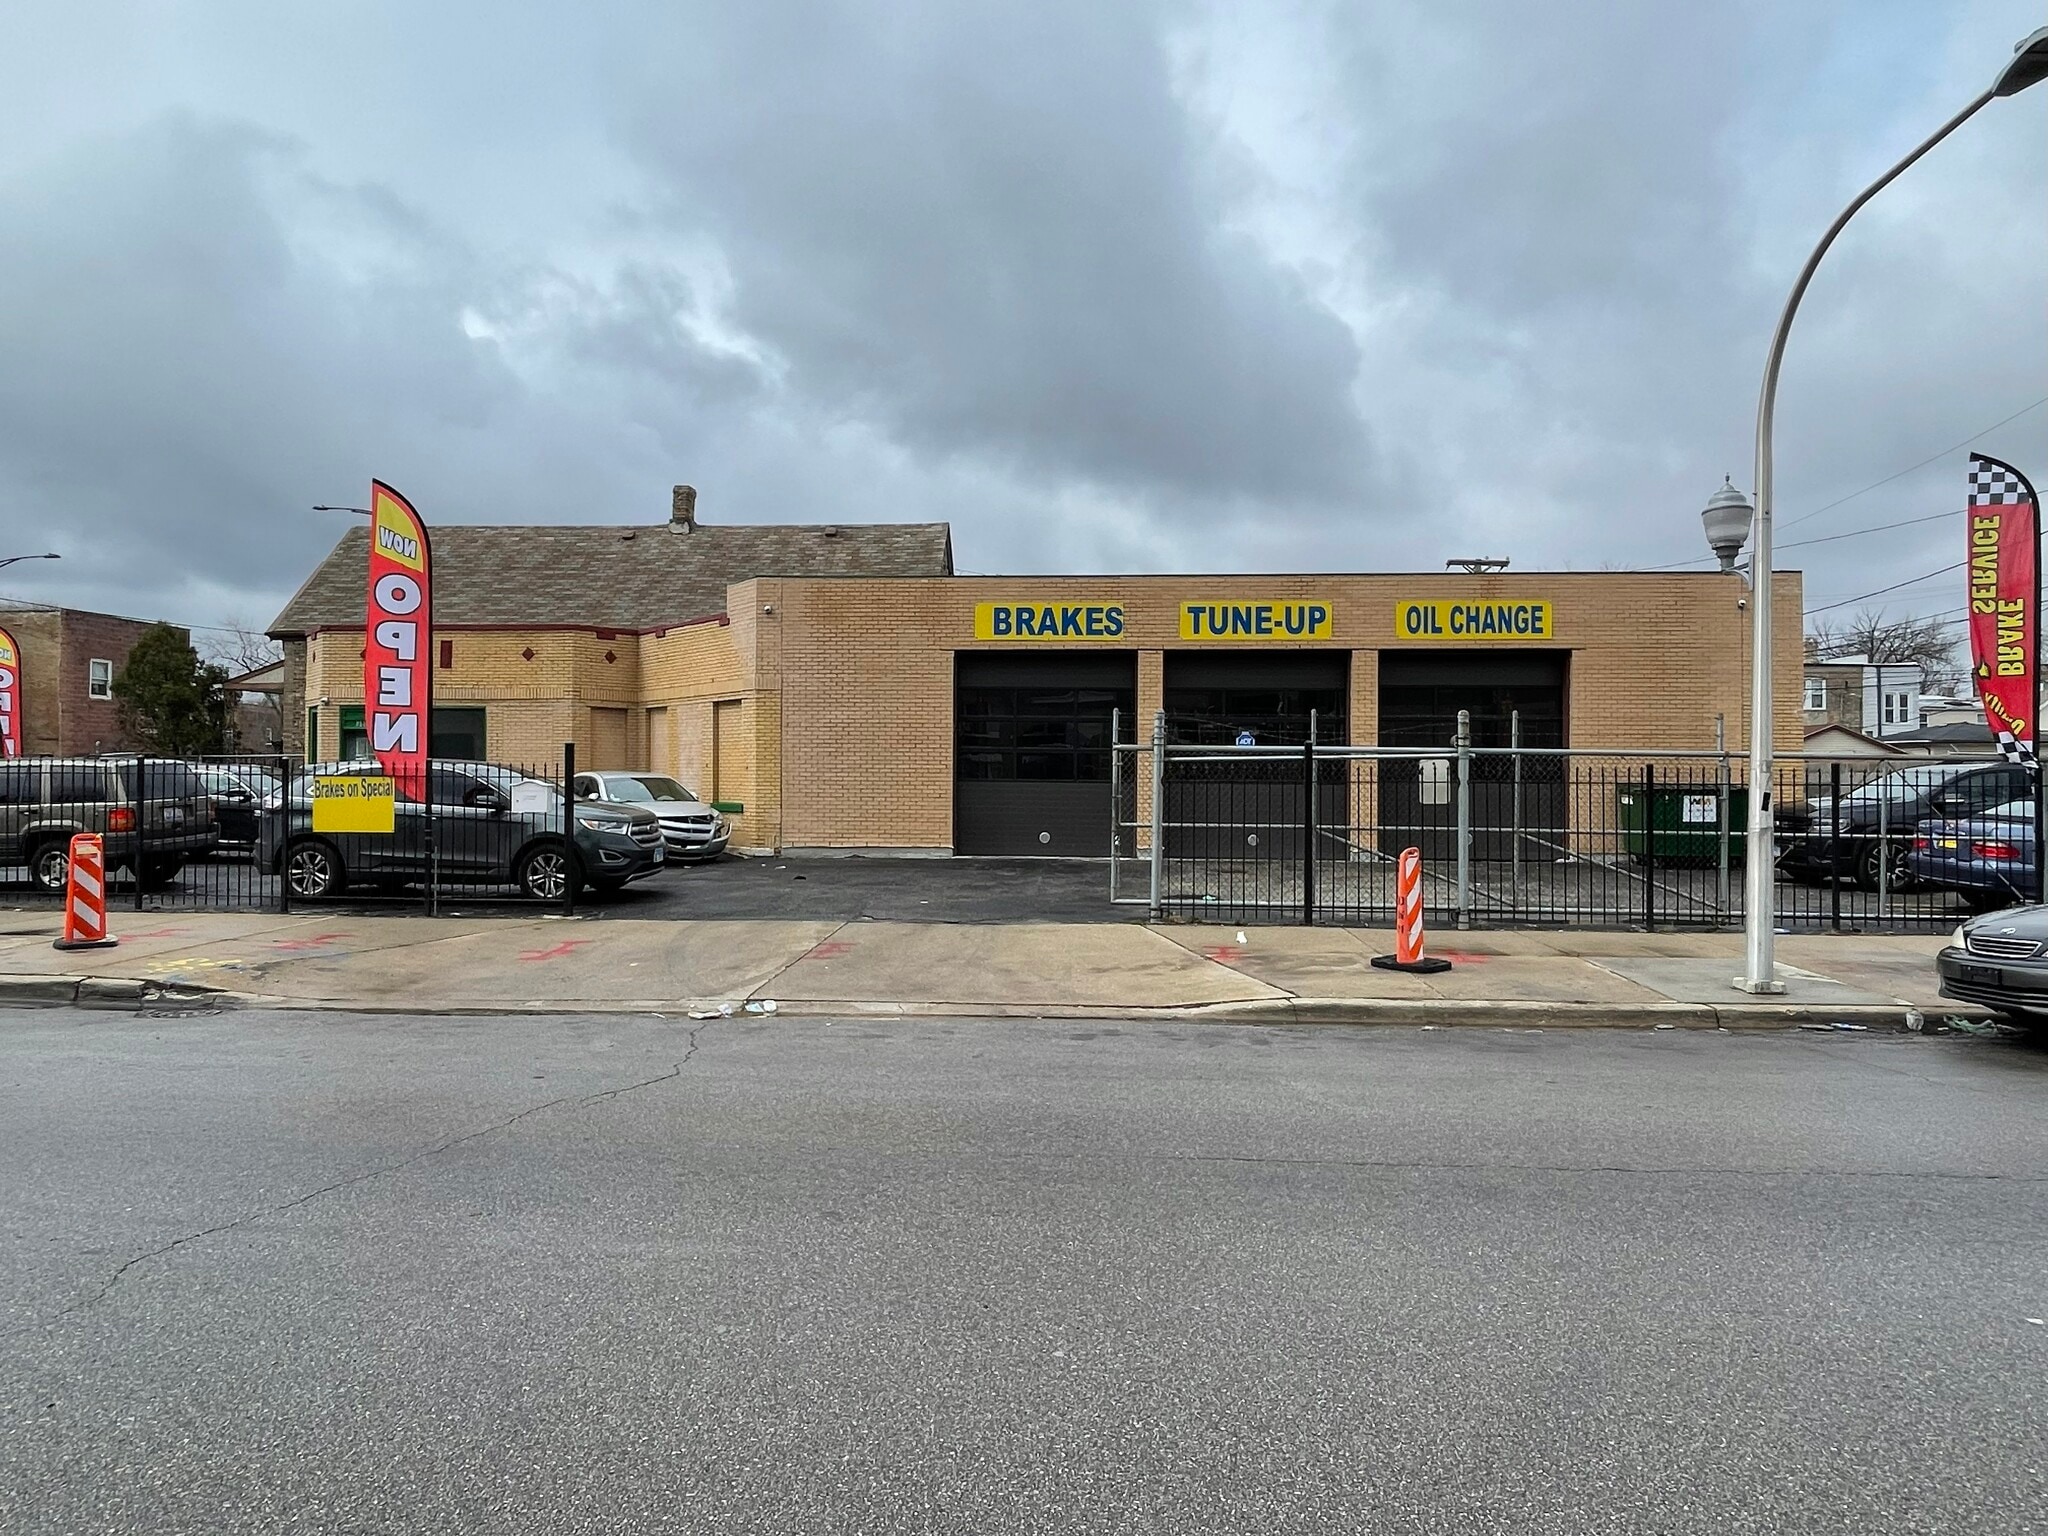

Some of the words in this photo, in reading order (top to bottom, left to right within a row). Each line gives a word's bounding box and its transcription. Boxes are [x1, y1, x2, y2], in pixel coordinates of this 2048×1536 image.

[993, 606, 1123, 636] BRAKES
[1187, 606, 1326, 635] TUNE-UP
[1406, 606, 1442, 635] OIL
[1450, 605, 1544, 635] CHANGE
[314, 779, 345, 798] Brakes
[347, 782, 359, 797] on
[361, 777, 393, 801] Special
